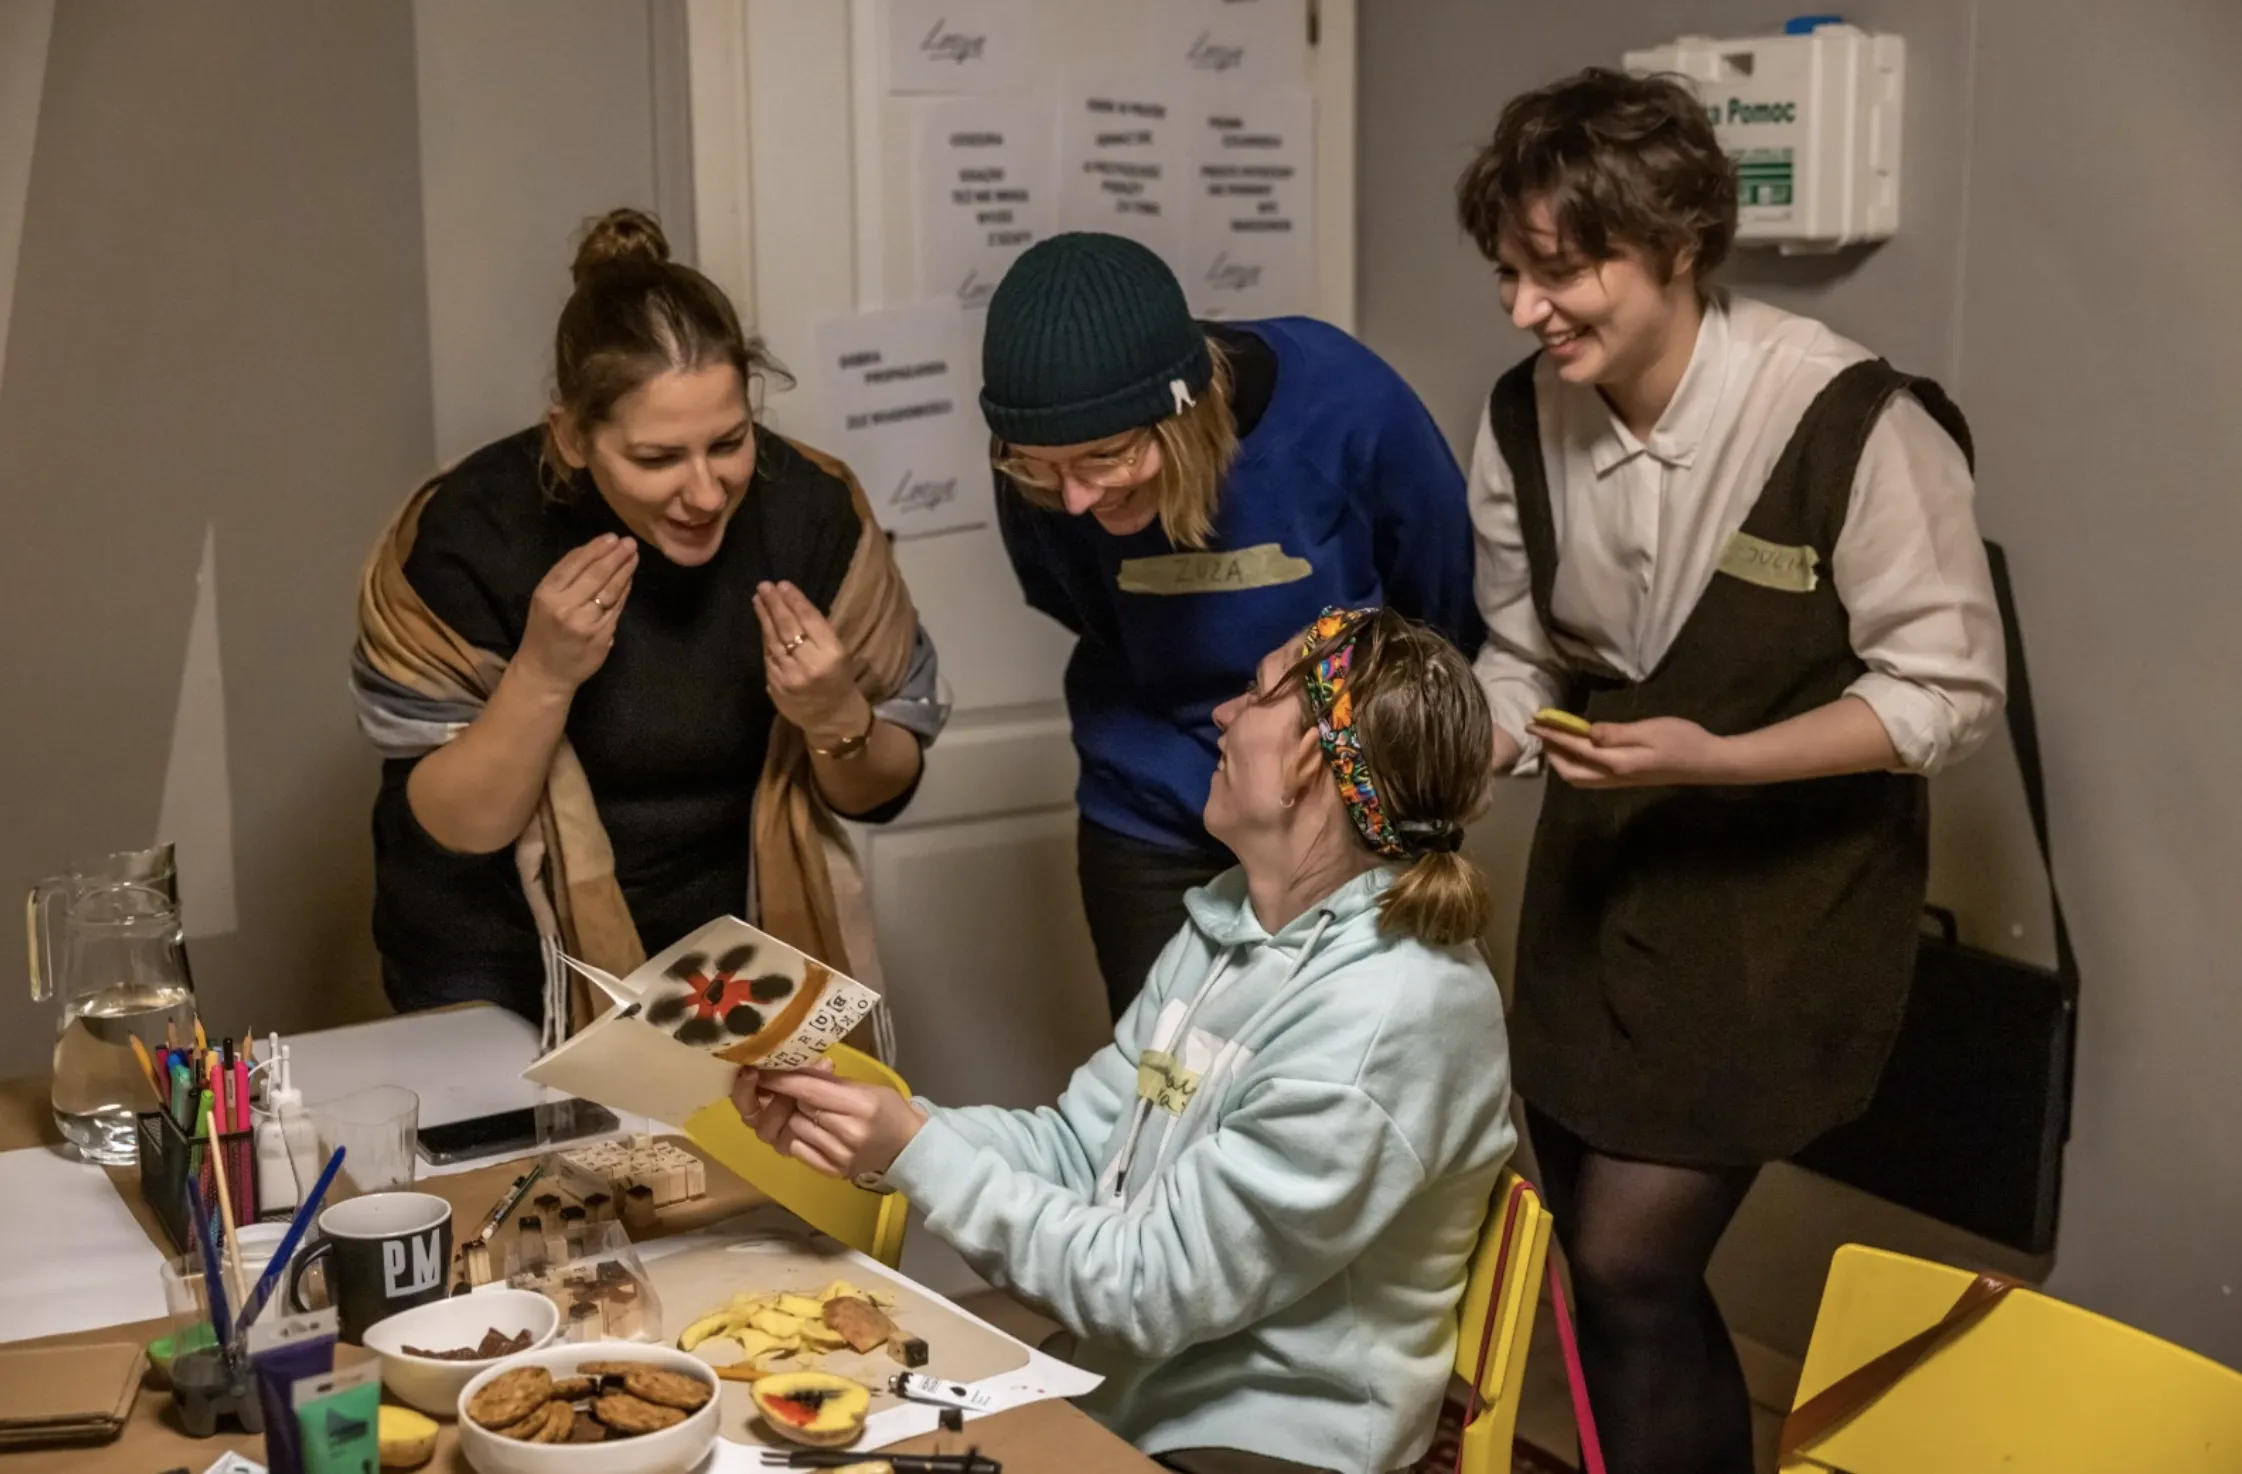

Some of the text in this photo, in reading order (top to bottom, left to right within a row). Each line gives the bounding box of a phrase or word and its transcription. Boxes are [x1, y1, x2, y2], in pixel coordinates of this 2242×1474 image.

[1727, 97, 1796, 126] Pomoc
[1173, 558, 1244, 584] ZUZA
[382, 1226, 440, 1299] PM
